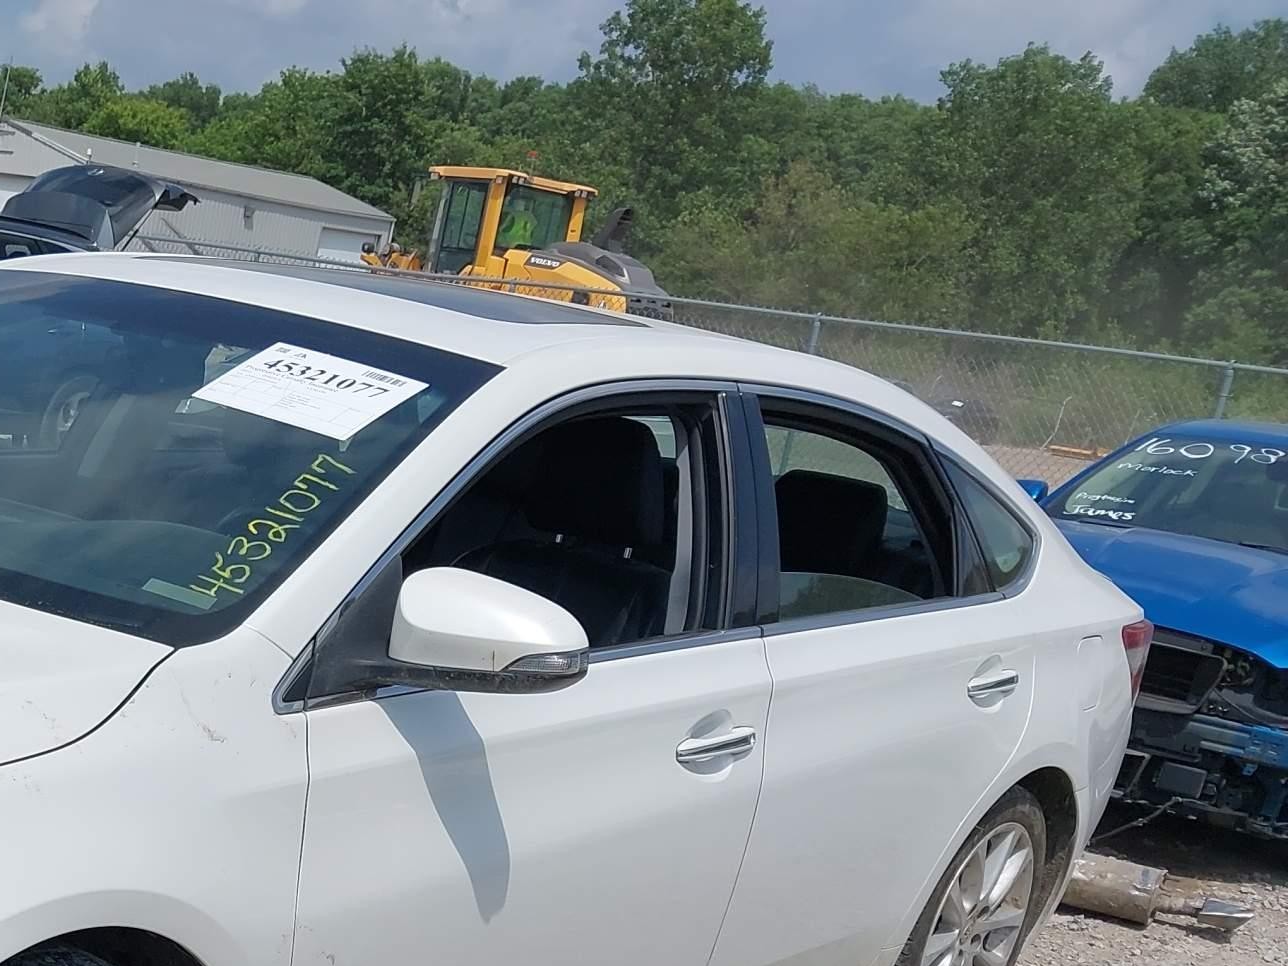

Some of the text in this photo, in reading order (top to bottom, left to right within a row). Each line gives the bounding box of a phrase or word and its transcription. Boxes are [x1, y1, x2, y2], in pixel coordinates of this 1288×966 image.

[531, 257, 560, 267] VOLVO
[263, 358, 390, 398] 45321077
[189, 453, 358, 597] 45321077
[1063, 503, 1137, 520] James
